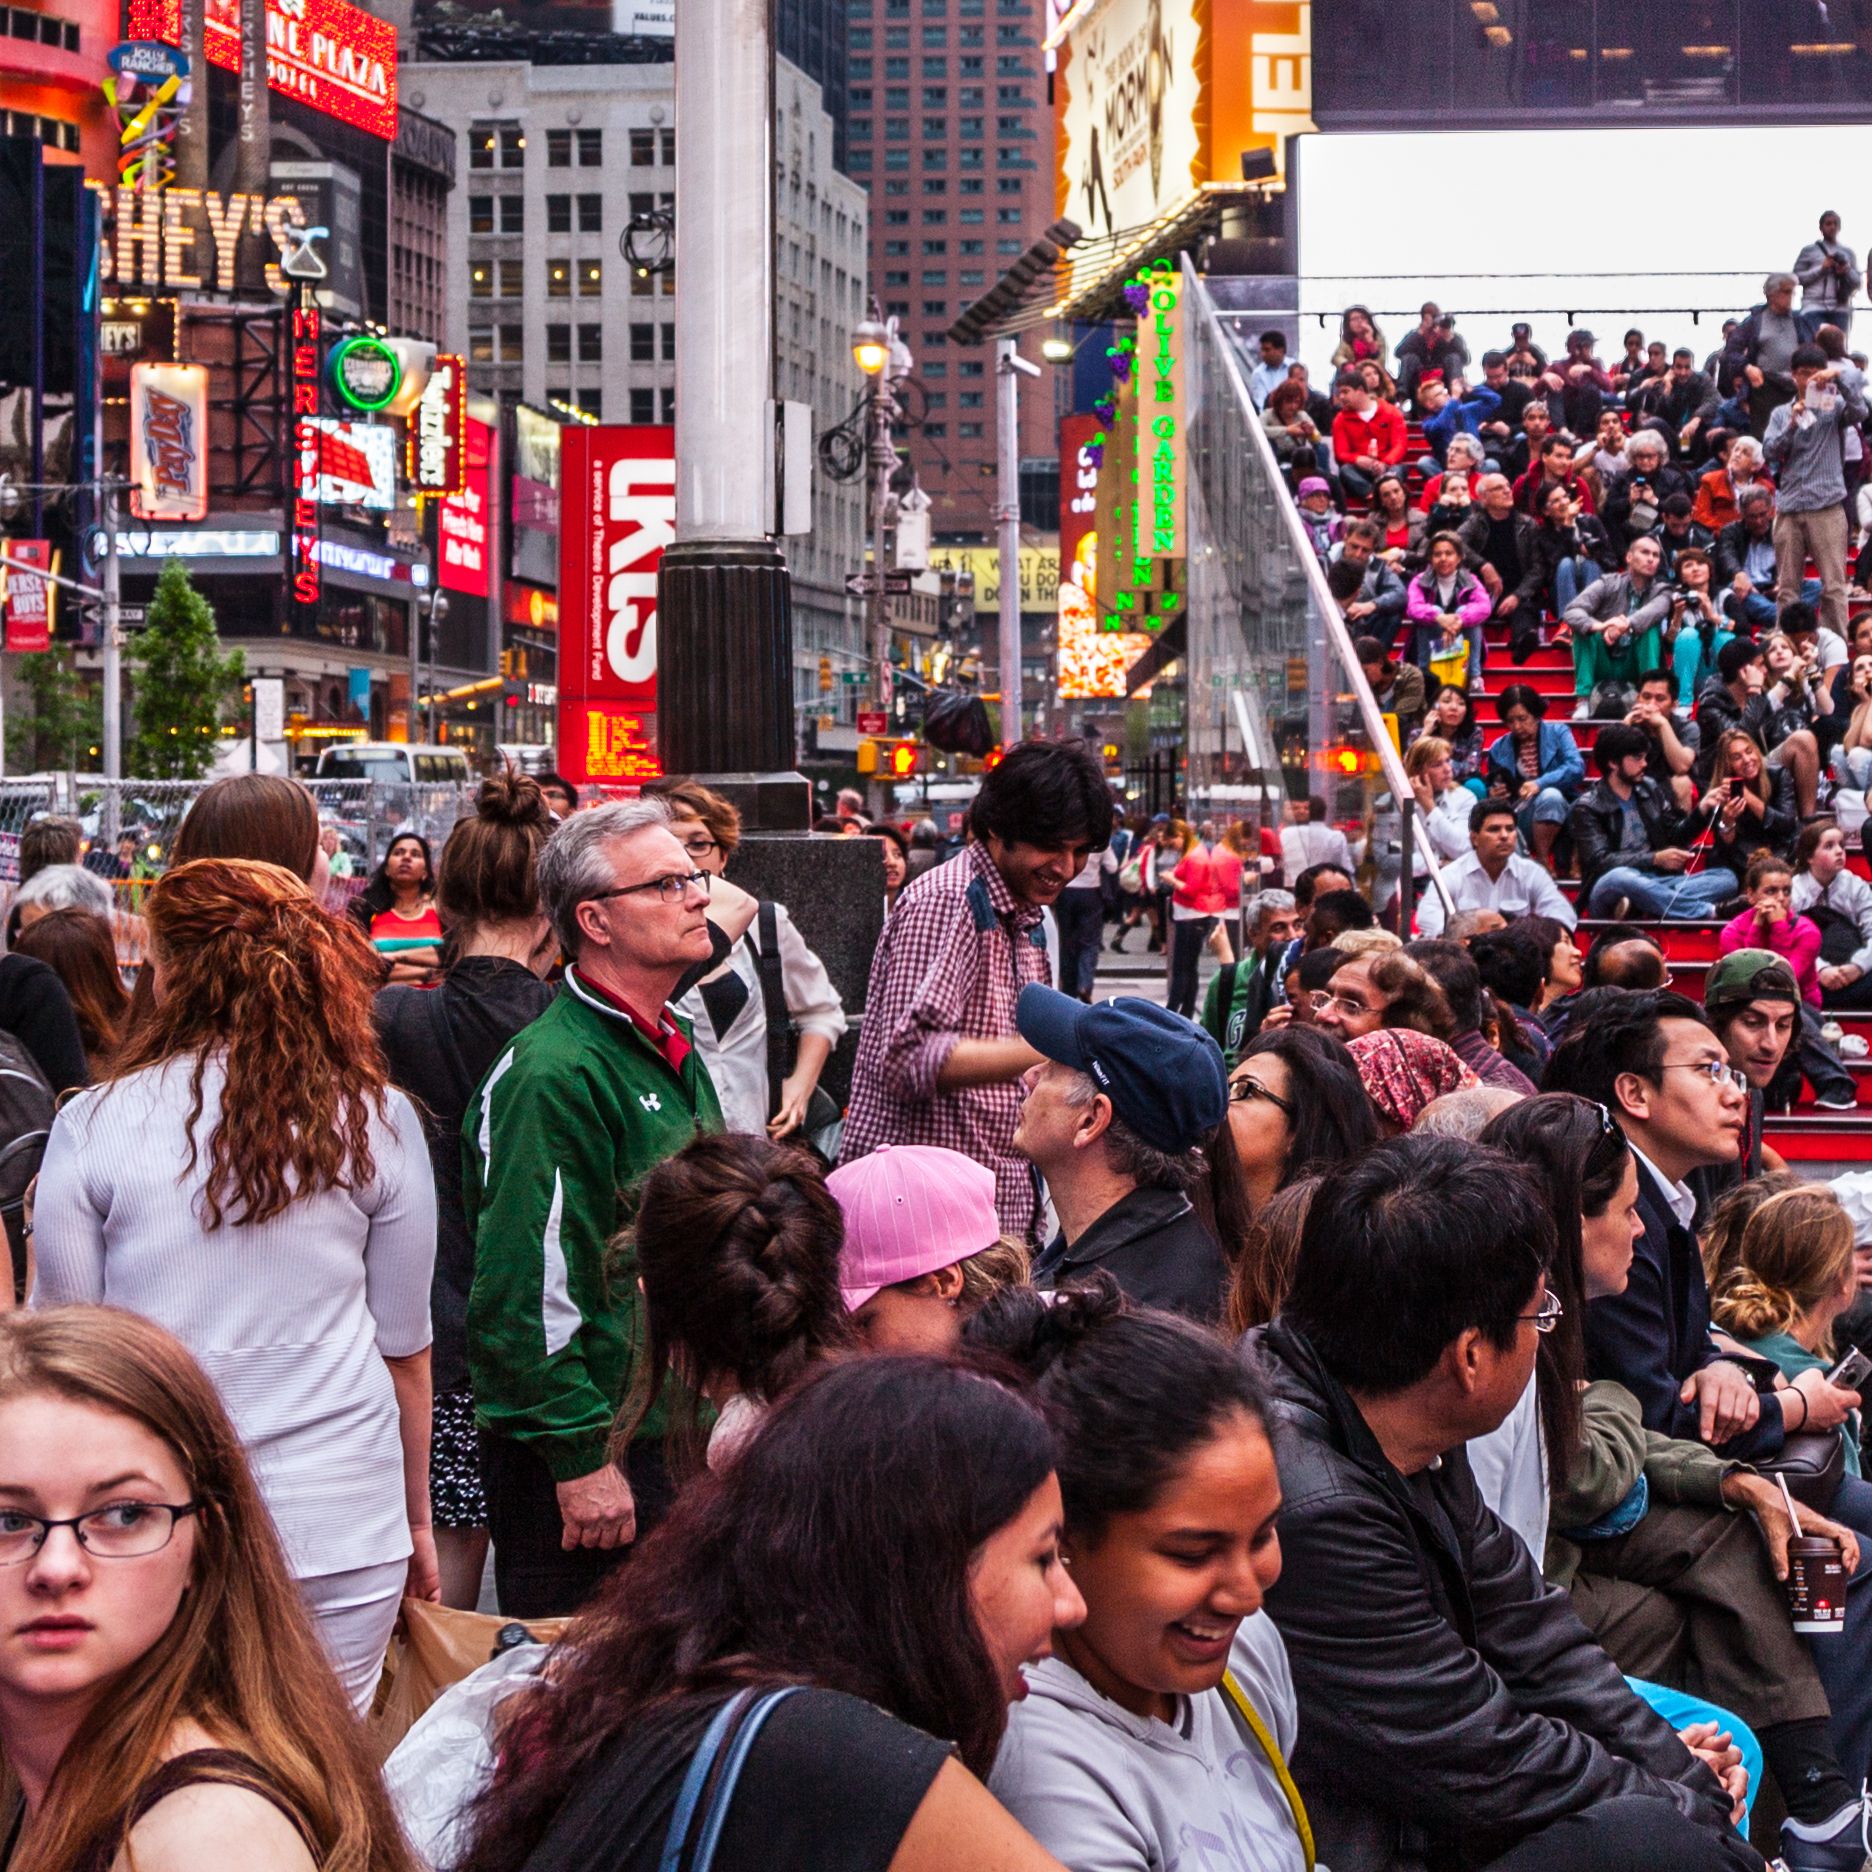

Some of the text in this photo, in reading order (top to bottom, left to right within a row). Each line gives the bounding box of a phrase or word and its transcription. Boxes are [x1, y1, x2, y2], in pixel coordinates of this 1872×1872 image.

[120, 56, 178, 77] RANCHER
[132, 46, 167, 63] JOLLY
[311, 30, 389, 97] PLAZA
[1151, 289, 1176, 553] OLIVE GARDEN
[143, 384, 197, 502] PayDay
[592, 470, 603, 514] service
[592, 515, 604, 527] of
[592, 528, 605, 573] Theatre
[989, 557, 1031, 571] WAT
[12, 591, 47, 616] BOYS
[984, 588, 1031, 603] DON
[591, 575, 605, 649] Development
[591, 652, 603, 681] Fund
